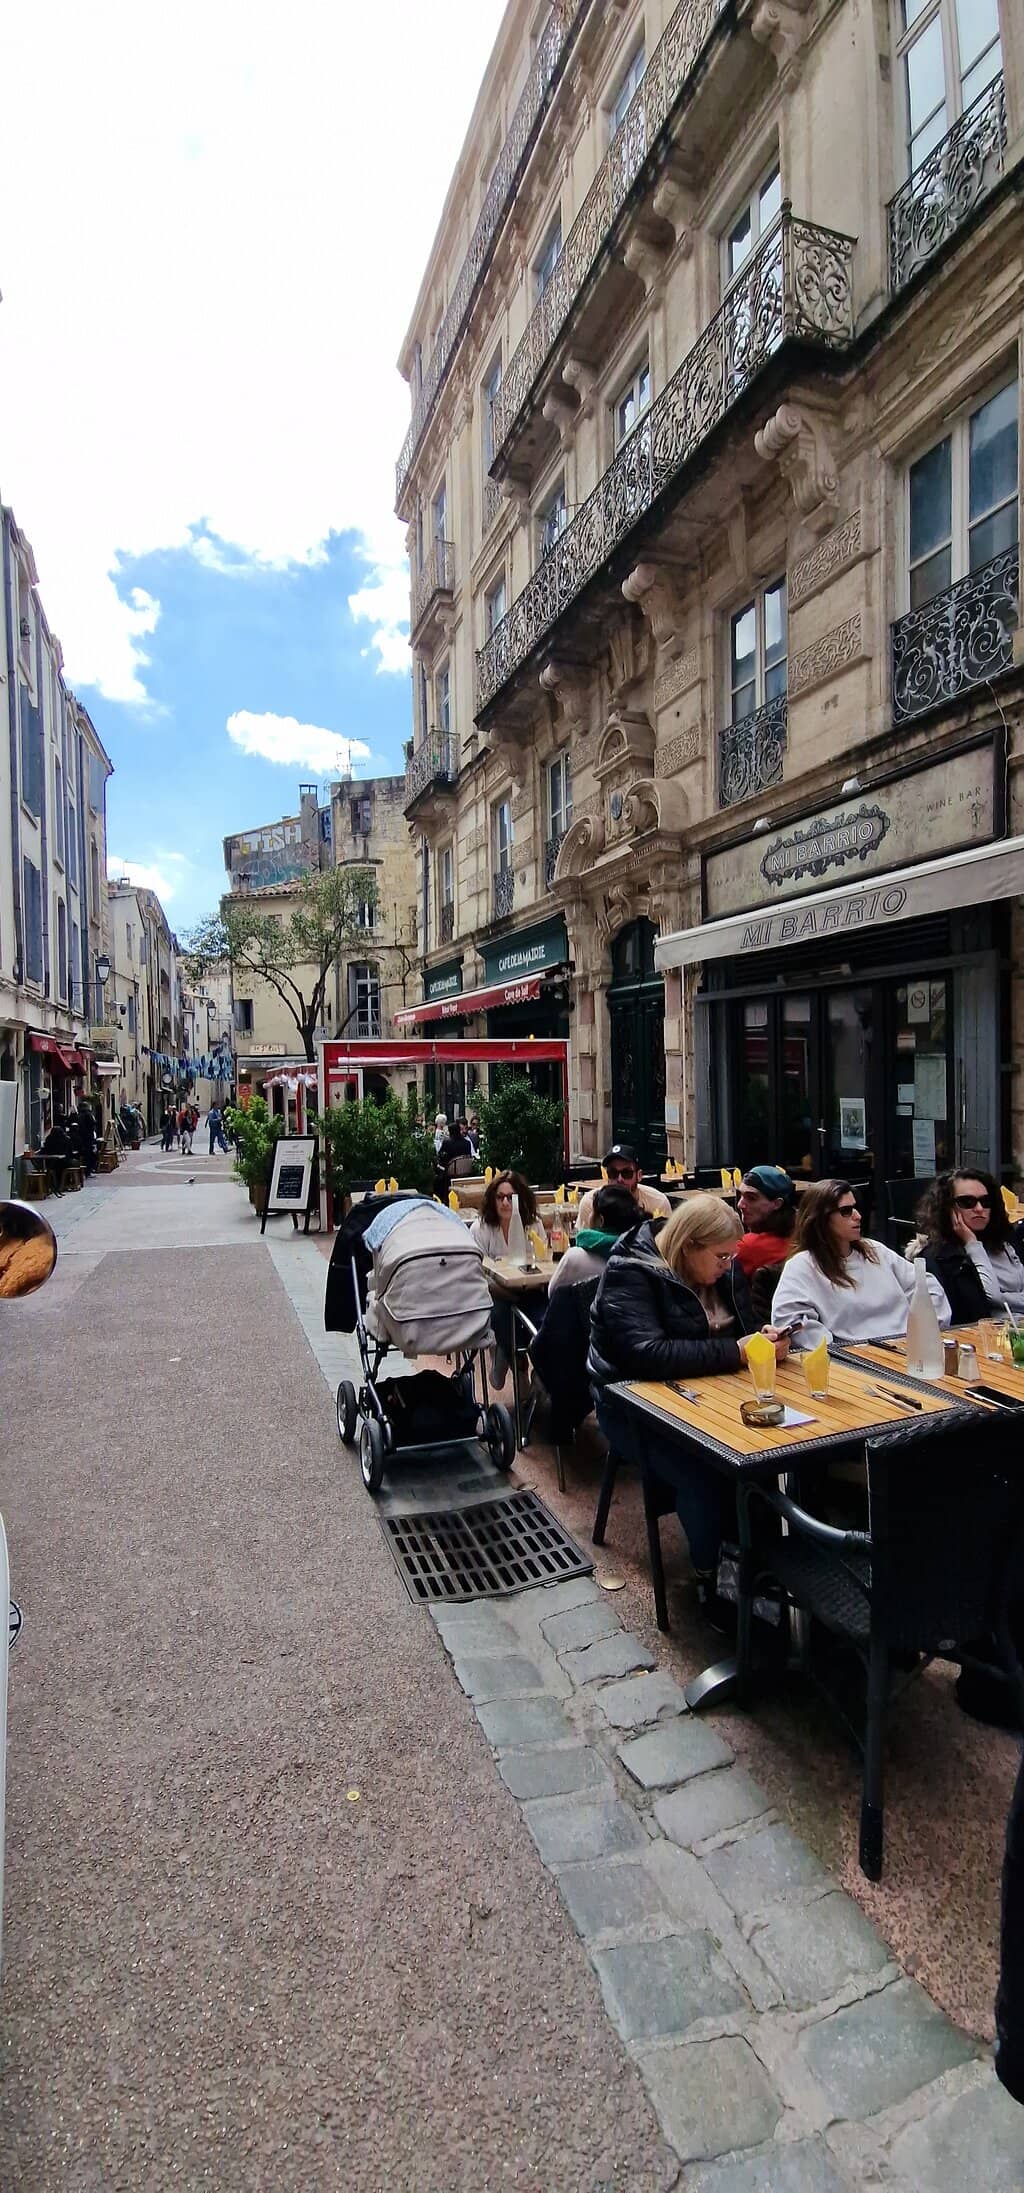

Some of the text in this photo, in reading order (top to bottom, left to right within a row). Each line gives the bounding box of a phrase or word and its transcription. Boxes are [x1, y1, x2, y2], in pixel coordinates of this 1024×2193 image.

[927, 785, 981, 813] WINE BAR
[770, 822, 874, 872] MI BARRIO
[740, 888, 907, 949] MI BARRIO
